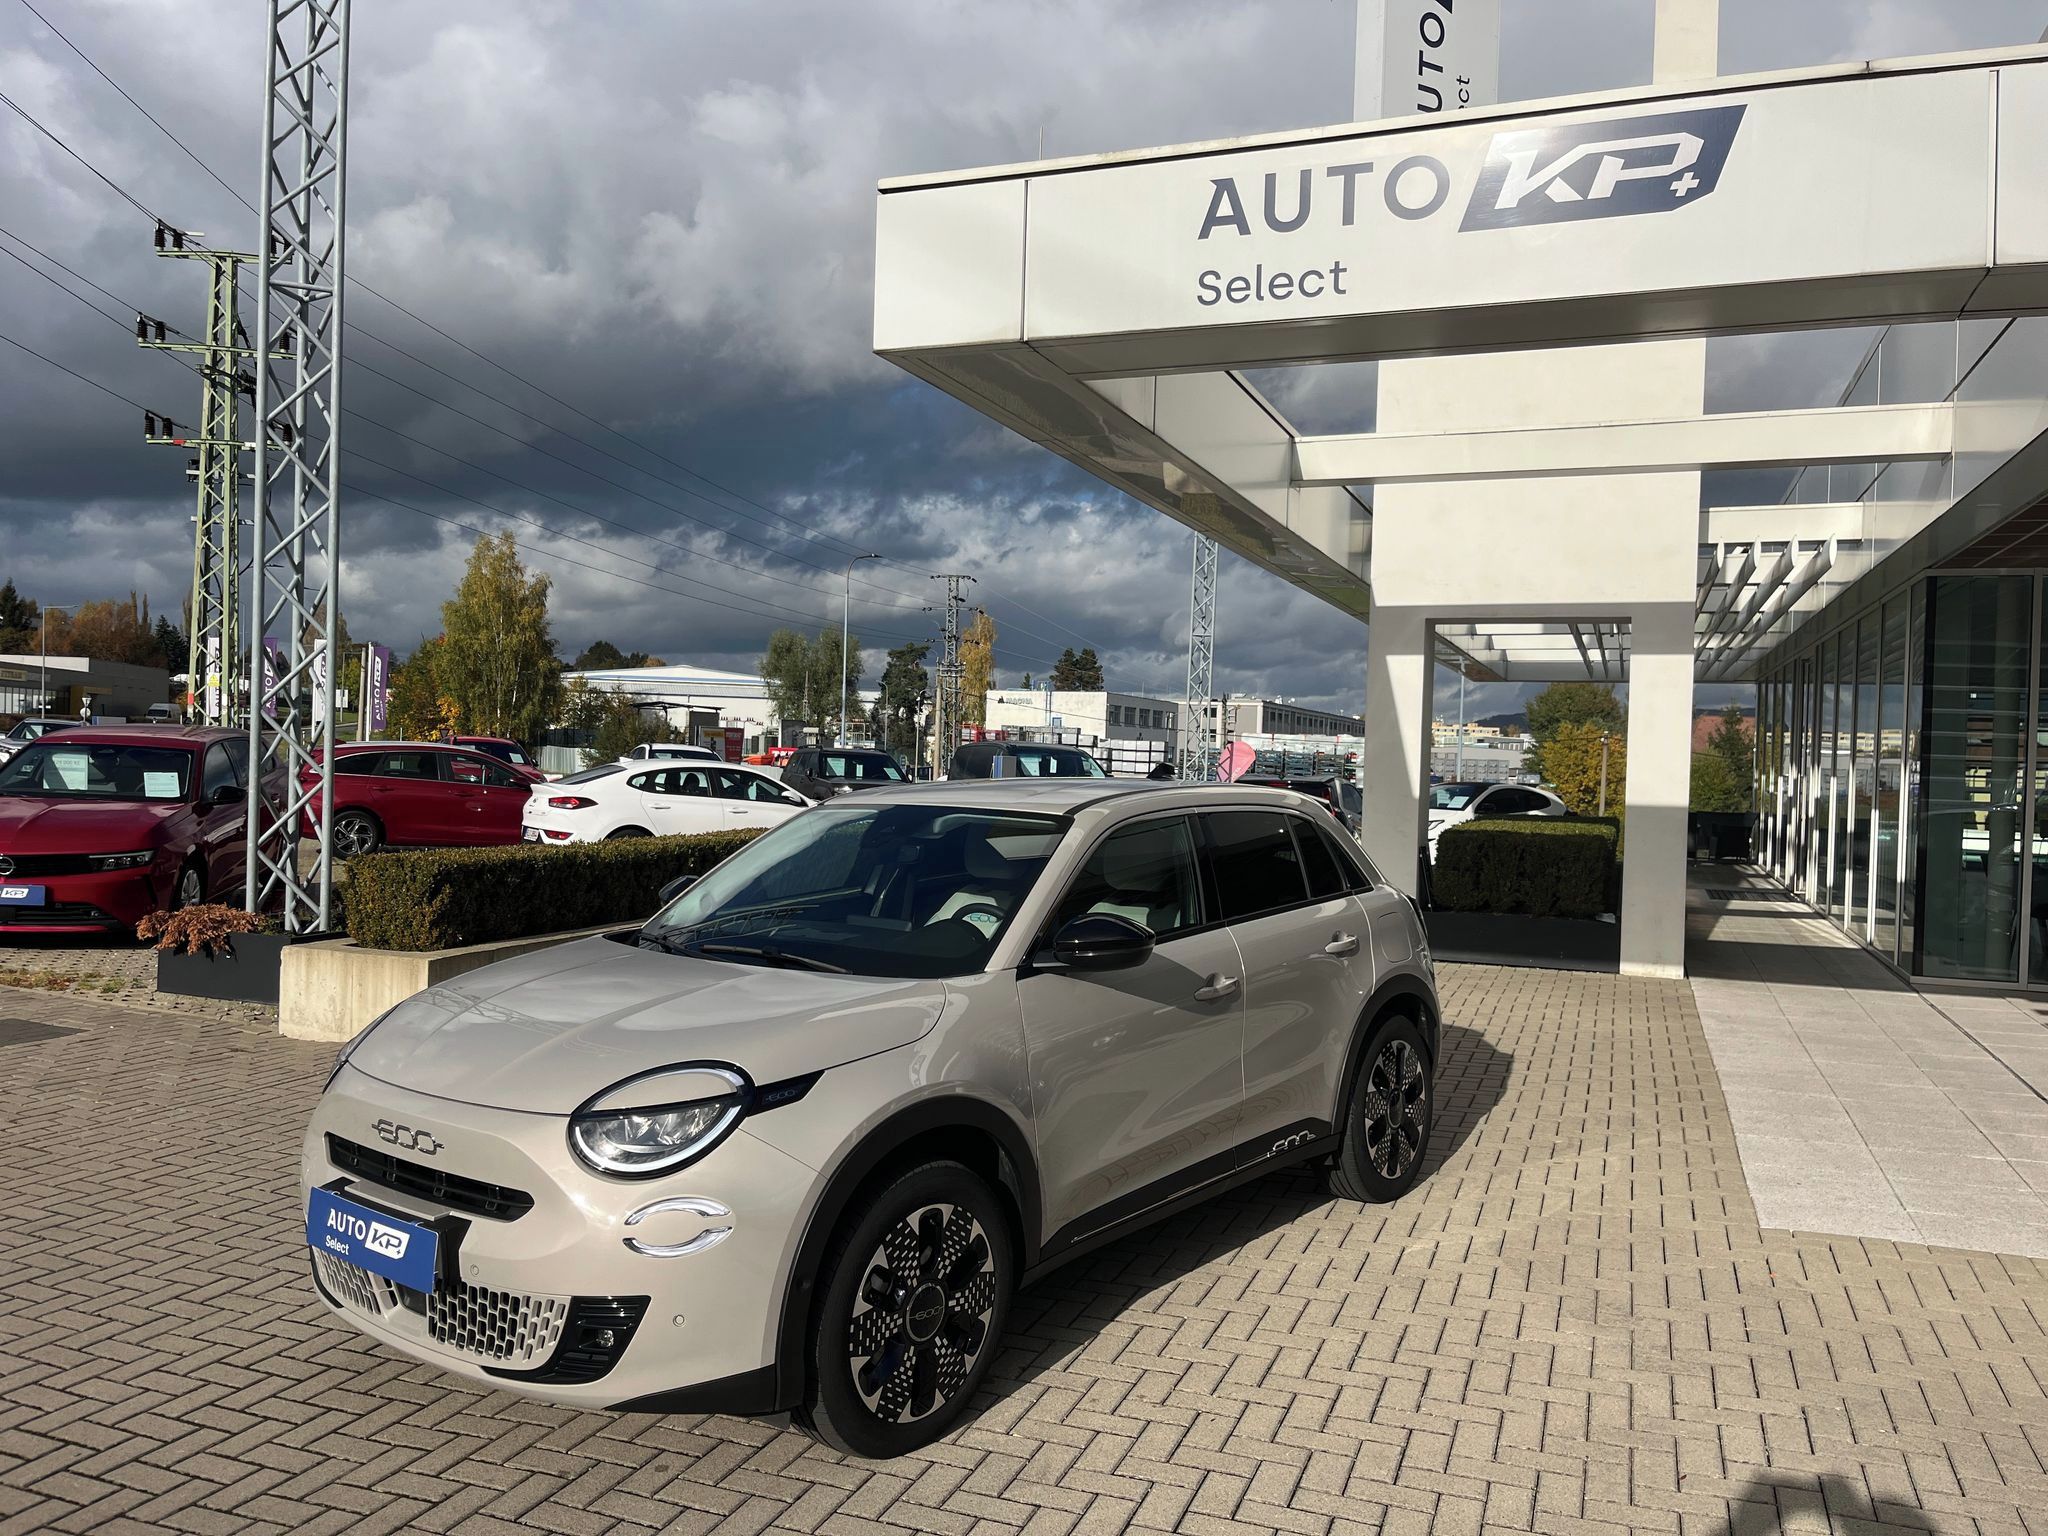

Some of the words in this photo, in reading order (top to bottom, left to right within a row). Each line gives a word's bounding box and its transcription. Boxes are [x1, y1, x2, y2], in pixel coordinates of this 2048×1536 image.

[1416, 11, 1446, 113] UTO
[1197, 155, 1451, 240] AUTO
[1197, 260, 1348, 306] Select
[373, 1118, 442, 1156] 600
[325, 1235, 350, 1256] Select
[327, 1208, 367, 1241] AUTO
